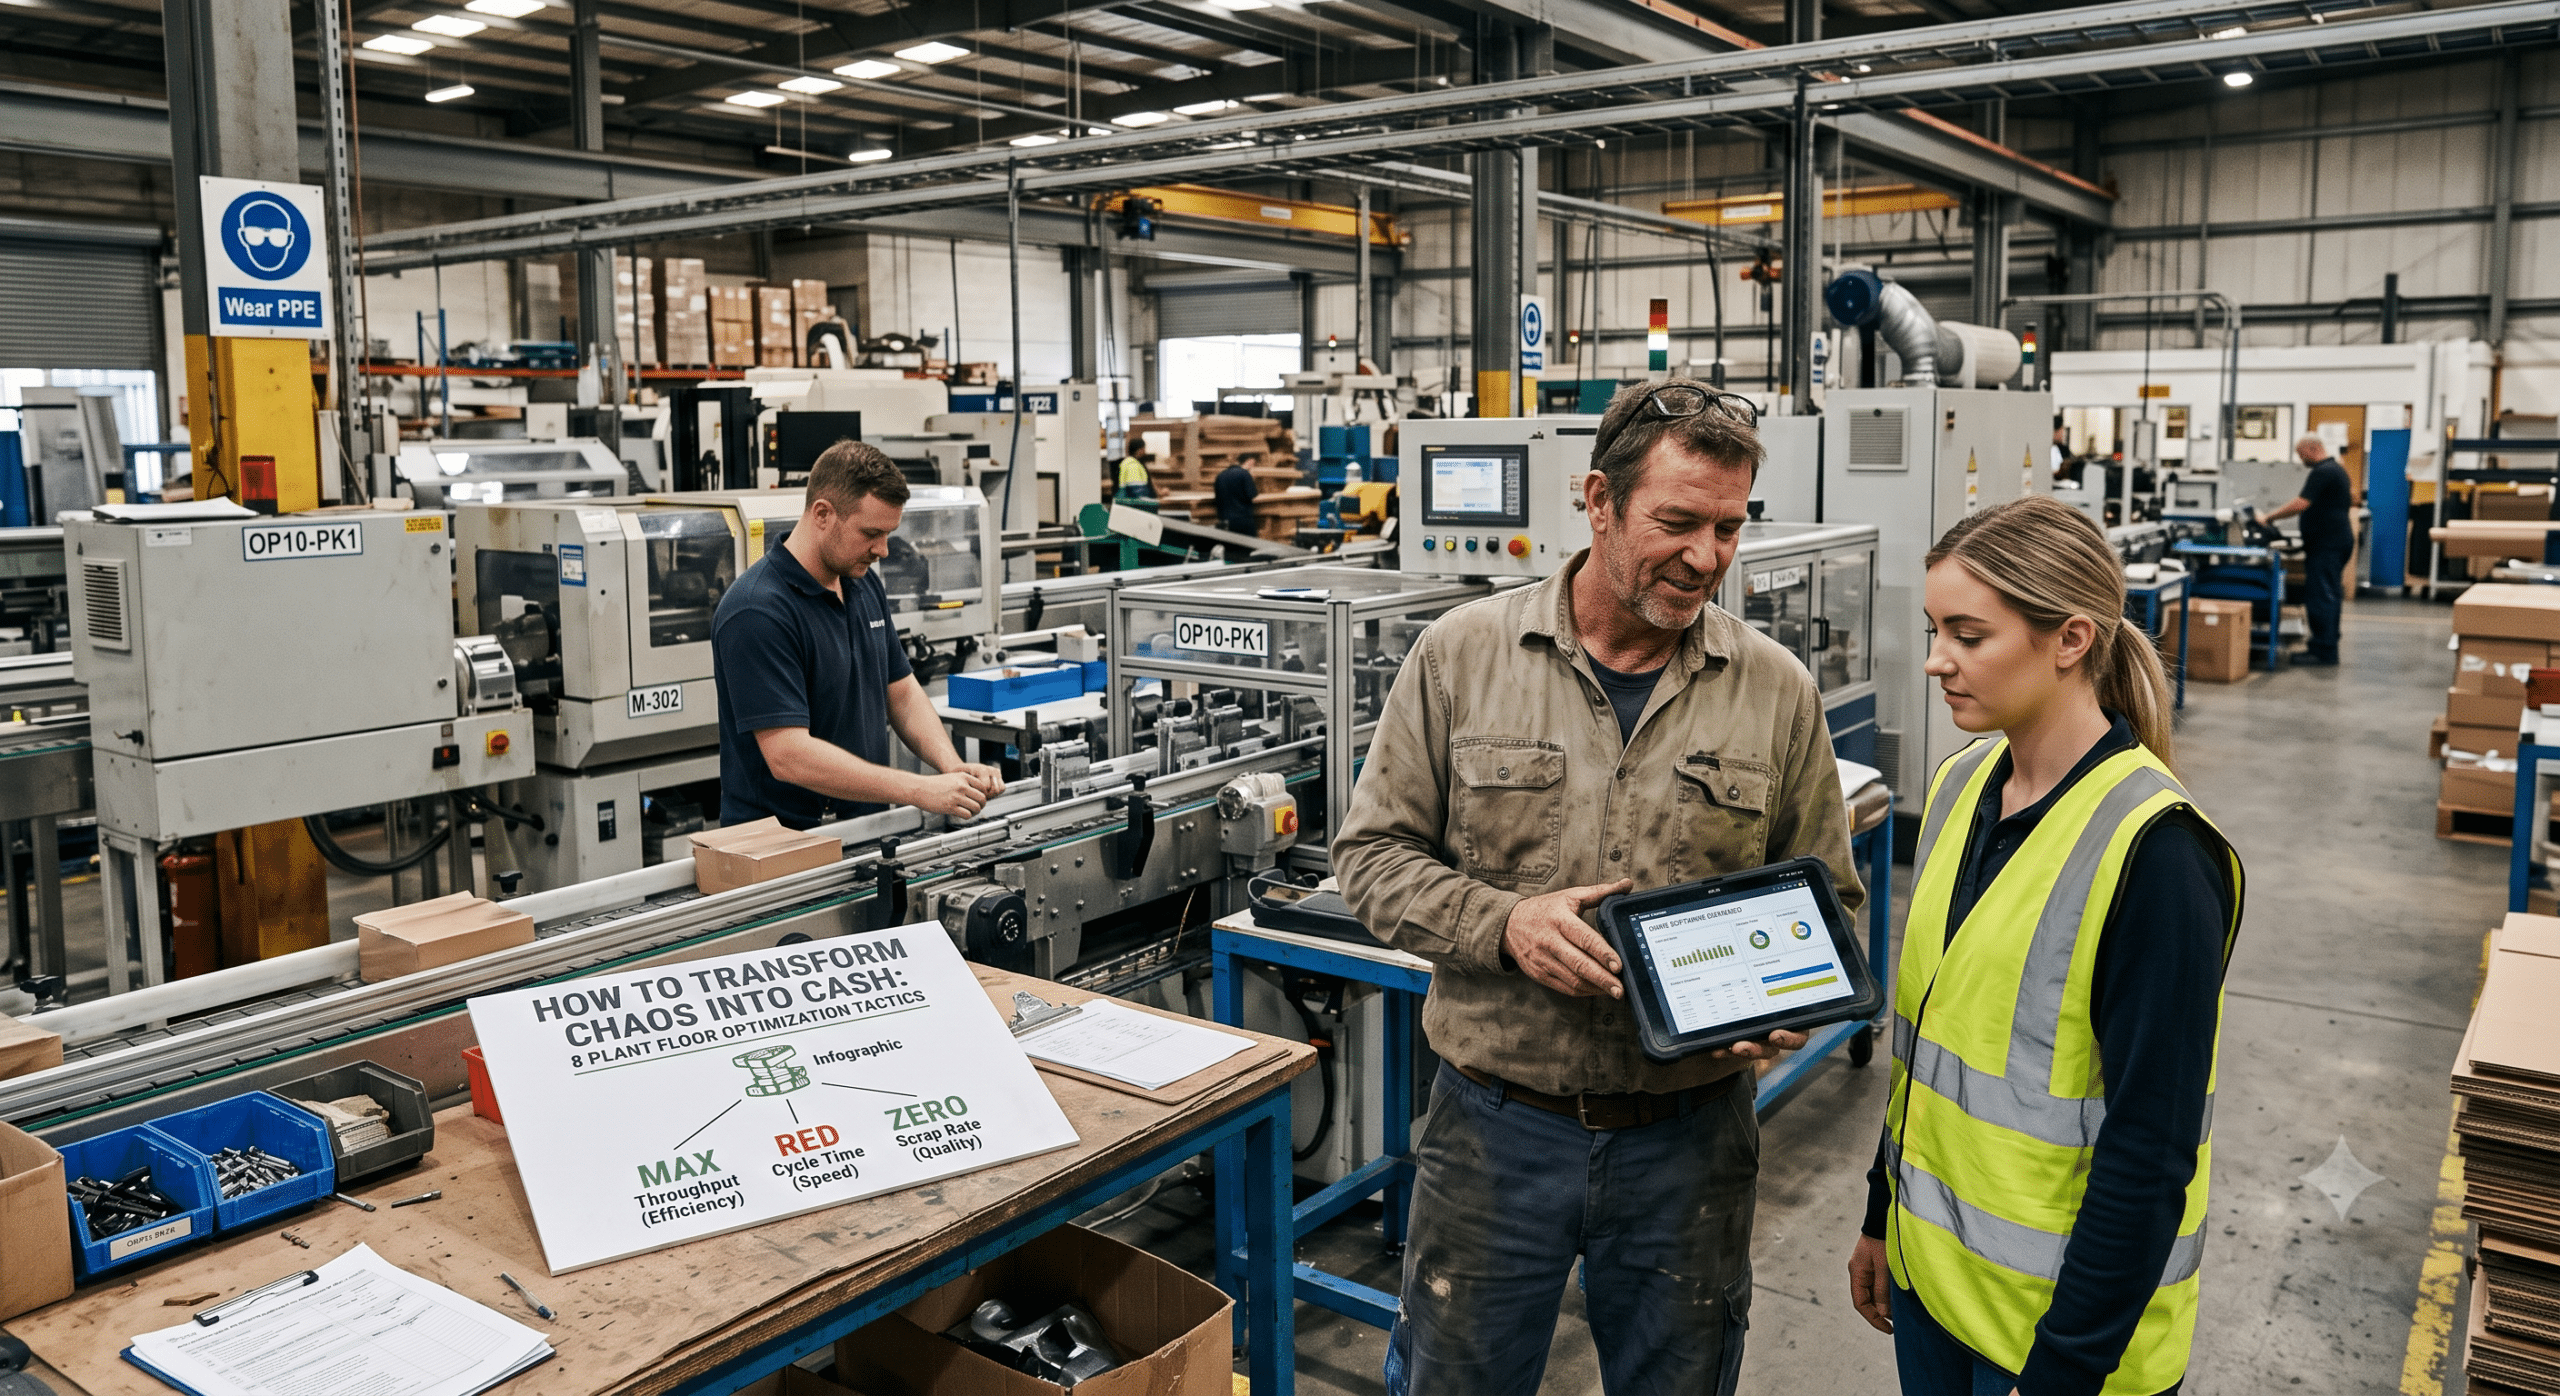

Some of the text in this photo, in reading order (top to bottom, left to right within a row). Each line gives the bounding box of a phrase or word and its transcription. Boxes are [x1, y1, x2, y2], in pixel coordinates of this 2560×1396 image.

[225, 297, 316, 319] Wear PPE
[249, 528, 356, 554] OP10-PK1
[1179, 623, 1263, 651] OP10-PK1
[632, 689, 679, 713] M-302
[532, 938, 908, 1023] HOW TO TRANSFORM
[565, 967, 908, 1047] CHAOS INTO CASH:
[572, 990, 925, 1068] 8 PLANT FLOOR OPTIMIZATION TACTICS
[813, 1039, 903, 1066] Infographic
[884, 1095, 968, 1131] ZERO
[774, 1124, 840, 1157] RED
[896, 1120, 982, 1148] Scrap Rate
[913, 1134, 983, 1162] (Quality)
[637, 1149, 721, 1189] MAX
[771, 1147, 865, 1177] Cycle Time
[634, 1174, 741, 1209] Throughput
[792, 1163, 859, 1193] (Speed)
[641, 1190, 745, 1228] (Efficiency)
